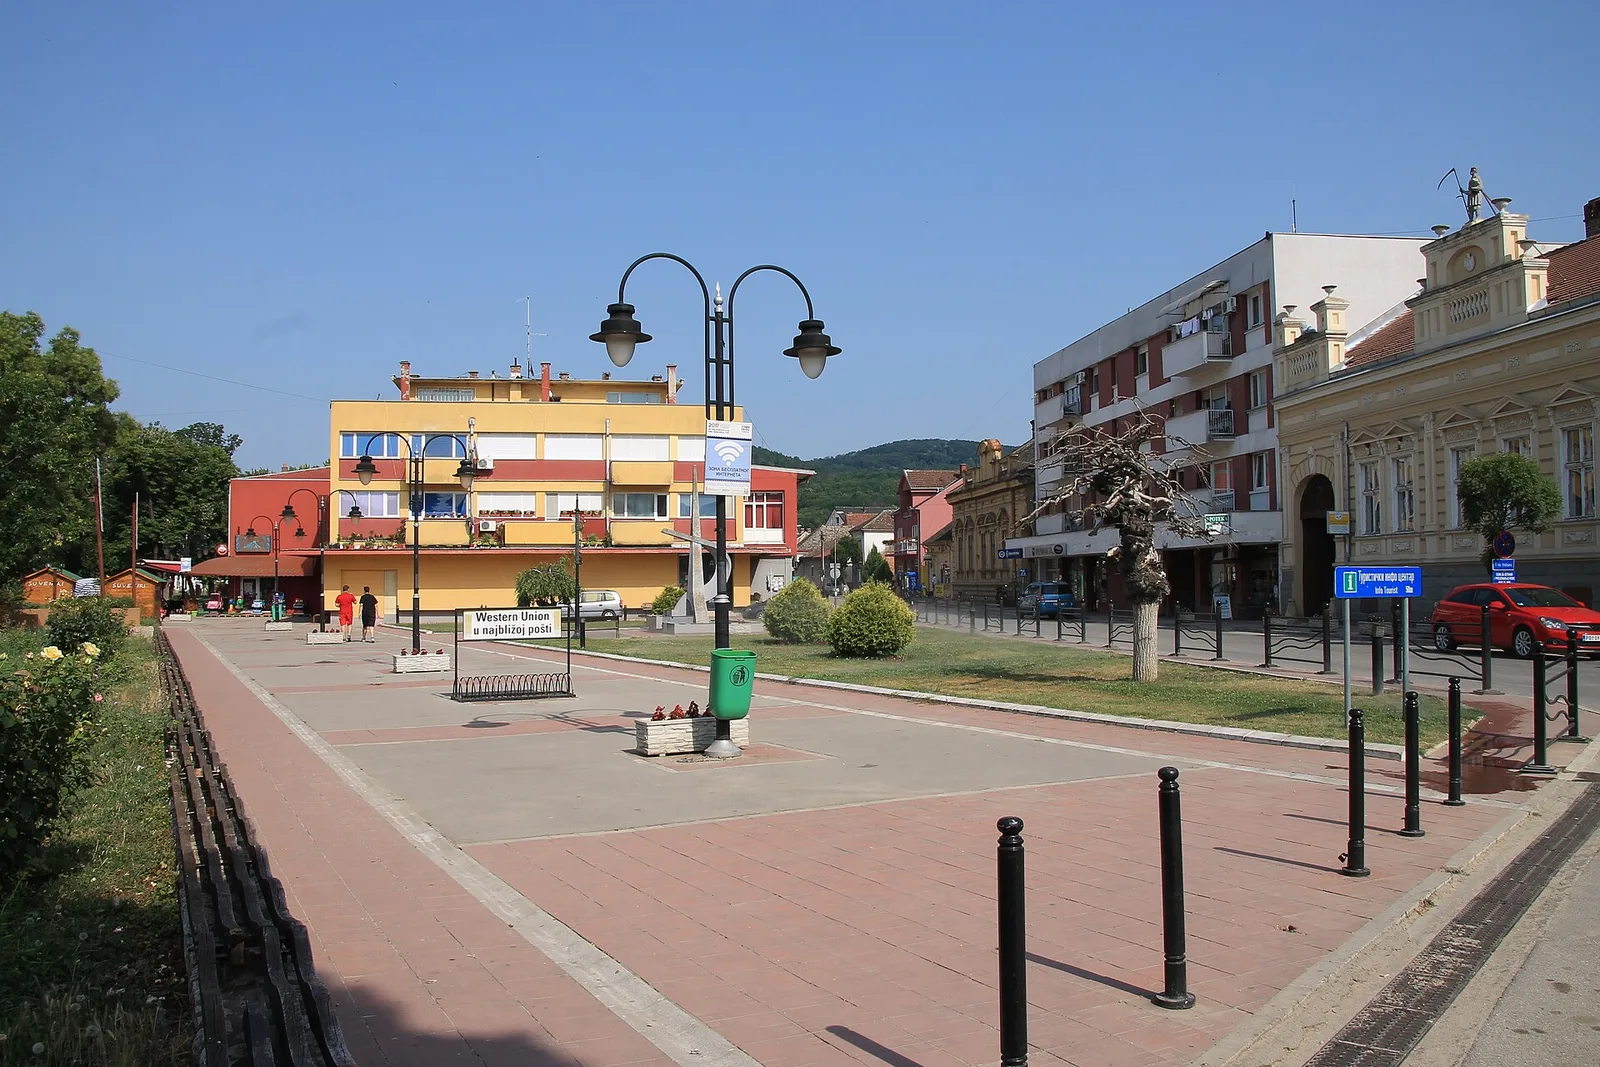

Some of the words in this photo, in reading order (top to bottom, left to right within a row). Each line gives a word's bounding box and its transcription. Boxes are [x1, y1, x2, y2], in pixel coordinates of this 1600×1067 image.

[1358, 570, 1384, 585] Туристички
[1385, 572, 1397, 582] инфо
[1398, 573, 1415, 584] центар
[1375, 586, 1383, 594] Info
[1384, 586, 1398, 594] Tourist
[476, 612, 518, 622] Western
[521, 611, 550, 621] Union
[482, 624, 525, 637] najbližoj
[528, 623, 552, 636] pošti
